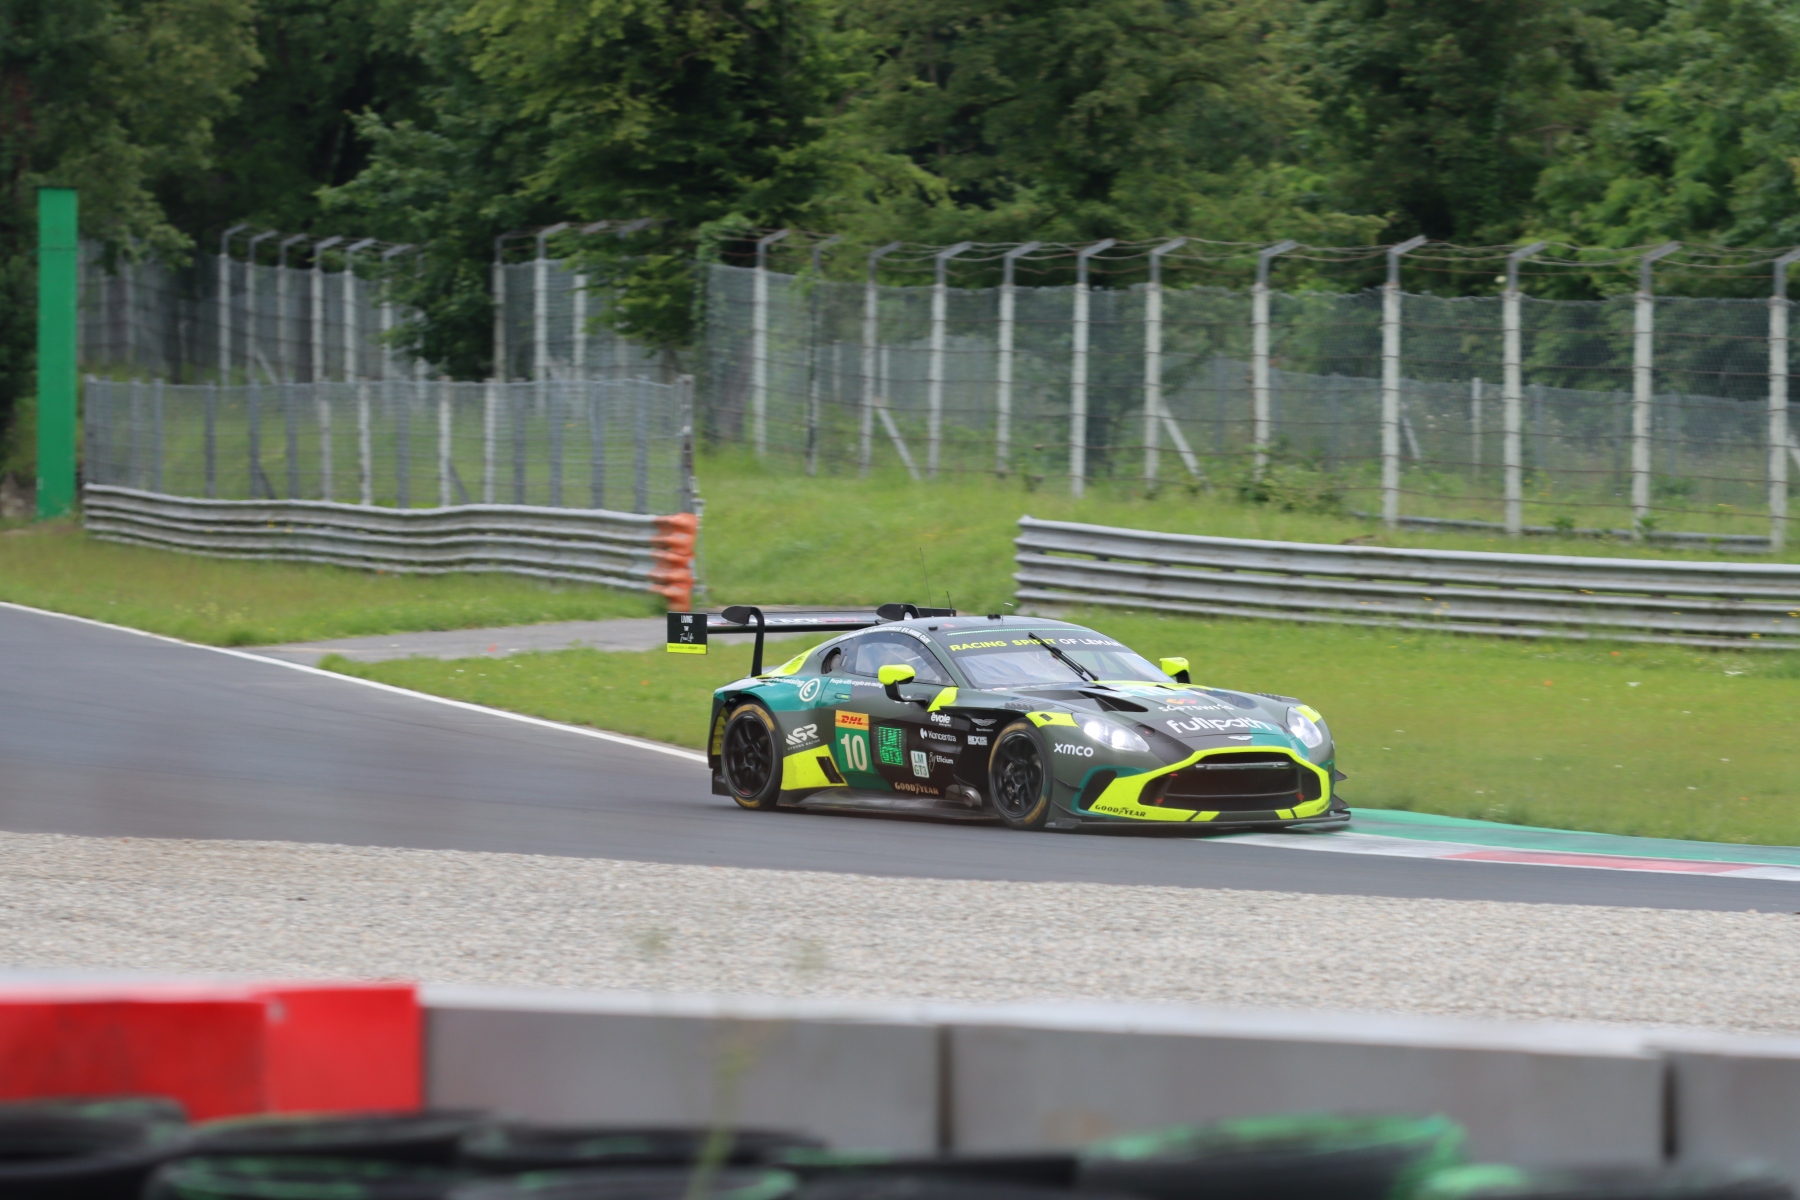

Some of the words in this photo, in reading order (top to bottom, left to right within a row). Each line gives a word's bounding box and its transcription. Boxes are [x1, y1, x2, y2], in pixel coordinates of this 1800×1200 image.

[949, 640, 1007, 651] RACING
[840, 715, 863, 725] DHL
[1166, 717, 1273, 734] fullpath
[927, 730, 957, 742] Koncentra
[840, 733, 868, 771] 10
[1053, 742, 1094, 757] xmco
[913, 752, 924, 764] LM
[914, 765, 928, 777] GT3
[894, 781, 939, 795] GOODYEAR
[1095, 804, 1147, 817] GOODYEAR
